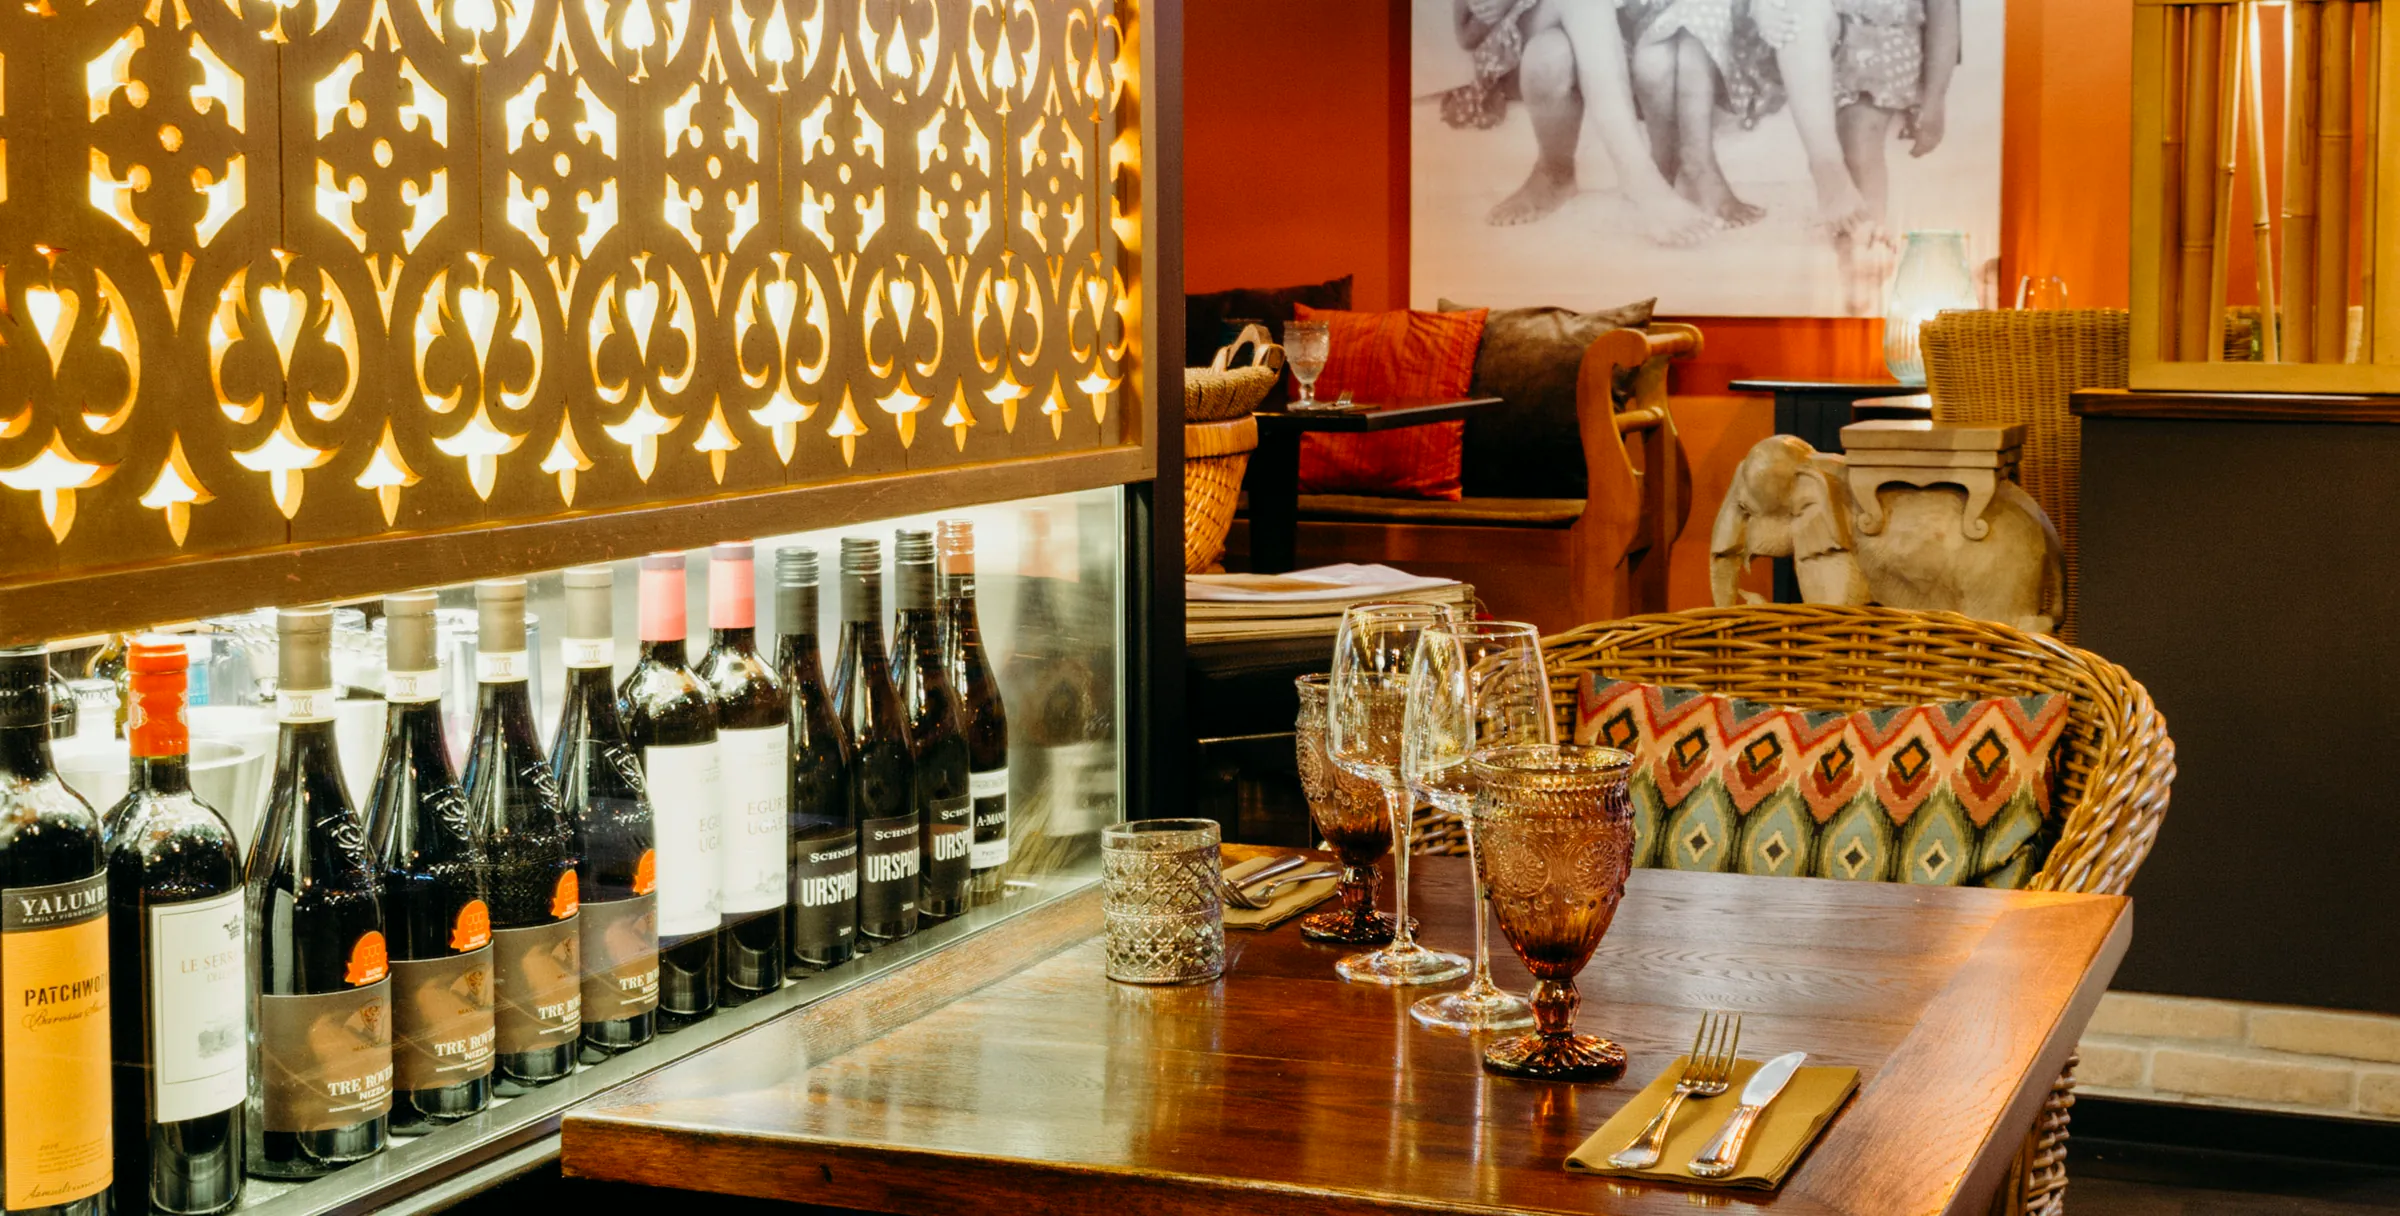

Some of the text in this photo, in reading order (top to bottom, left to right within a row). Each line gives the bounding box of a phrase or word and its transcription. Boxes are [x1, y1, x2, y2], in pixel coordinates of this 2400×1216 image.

[619, 974, 645, 991] TRE
[538, 1003, 565, 1020] TRE
[434, 1039, 466, 1057] TRE
[327, 1078, 362, 1097] TRE
[359, 1085, 386, 1101] NIZZA
